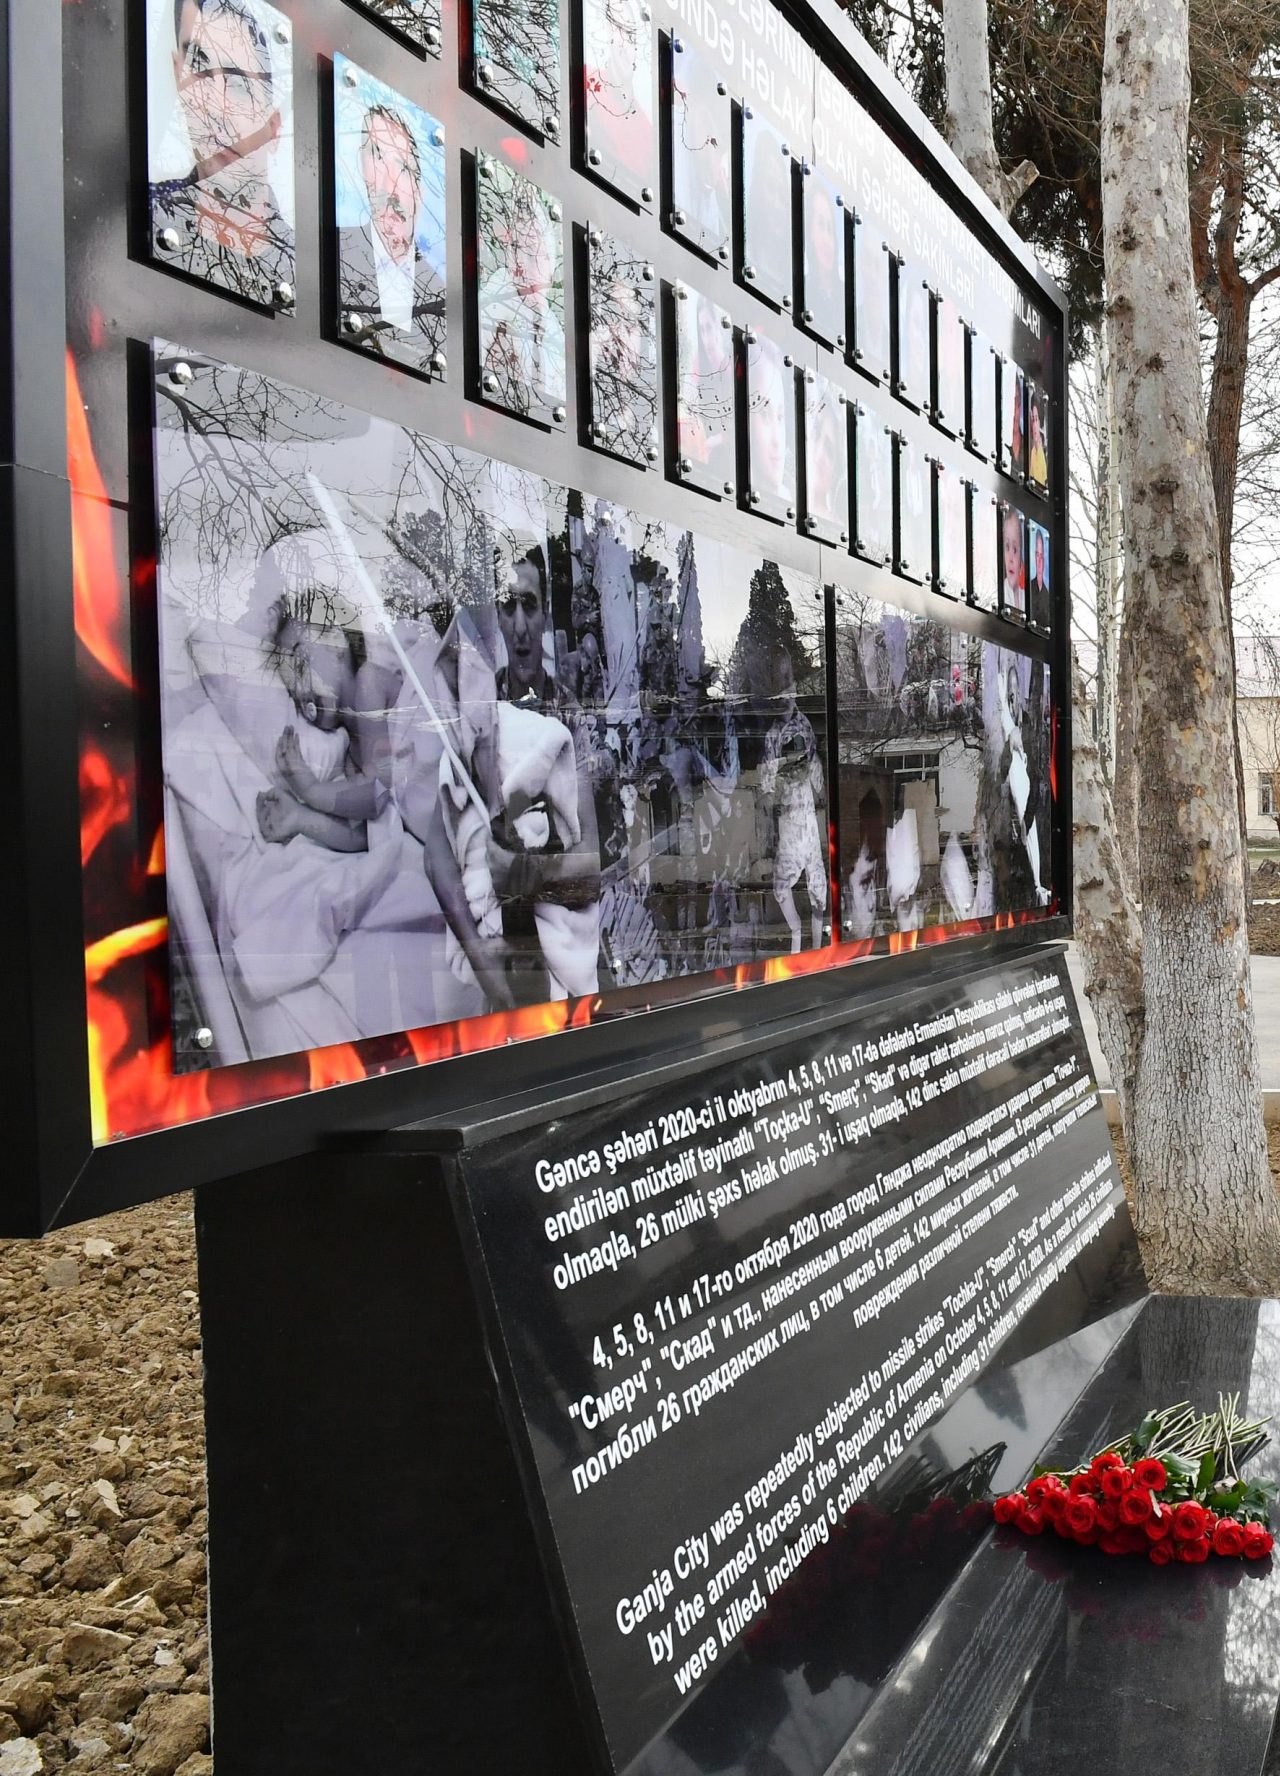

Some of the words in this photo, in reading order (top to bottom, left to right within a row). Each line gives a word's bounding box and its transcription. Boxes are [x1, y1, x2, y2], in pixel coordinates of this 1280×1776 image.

[742, 39, 808, 145] HƏLAK
[812, 116, 859, 193] OLAN
[535, 1149, 601, 1193] Gəncə
[602, 1120, 659, 1175] şəhəri
[657, 1099, 716, 1146] 2020-ci
[713, 1095, 728, 1123] il
[727, 1079, 788, 1118] oktyabrın
[788, 1069, 802, 1096] 4,
[798, 1064, 814, 1091] 5,
[811, 1060, 826, 1086] 8,
[823, 1053, 839, 1079] 11
[837, 1054, 853, 1074] və
[851, 1040, 880, 1068] 17-də
[878, 1026, 916, 1058] dəfələrlə
[912, 1013, 957, 1043] Ermənistan
[953, 998, 997, 1027] Respublikası
[544, 1185, 631, 1242] endirilən
[630, 1148, 698, 1204] müxtəlif
[697, 1126, 755, 1174] təyinatlı
[896, 1063, 910, 1082] və
[908, 1053, 931, 1078] digər
[929, 1042, 951, 1067] raket
[948, 1029, 986, 1059] zərbələrinə
[553, 1230, 637, 1290] olmaqla,
[635, 1212, 660, 1249] 26
[660, 1189, 707, 1236] mülki
[706, 1178, 743, 1219] şəxs
[740, 1155, 780, 1195] həlak
[779, 1142, 820, 1175] olmuş.
[843, 1115, 872, 1145] uşaq
[869, 1095, 909, 1129] olmaqla,
[905, 1086, 923, 1111] 142
[921, 1079, 941, 1102] dinc
[939, 1068, 961, 1093] sakin
[958, 1053, 987, 1083] müxtəlif
[571, 1415, 658, 1495] погибли
[656, 1391, 681, 1433] 26
[681, 1328, 781, 1417] гражданских
[779, 1309, 811, 1344] лиц,
[809, 1299, 821, 1321] в
[818, 1282, 844, 1313] том
[842, 1259, 877, 1294] числе
[874, 1247, 885, 1271] 6
[883, 1227, 915, 1271] детей.
[913, 1215, 931, 1244] 142
[929, 1195, 964, 1232] мирных
[592, 1335, 613, 1370] 4,
[612, 1323, 635, 1357] 5,
[633, 1312, 655, 1345] 8,
[654, 1295, 676, 1331] 11
[677, 1293, 693, 1319] и
[692, 1270, 734, 1308] 17-го
[734, 1235, 791, 1284] октября
[789, 1212, 820, 1251] 2020
[819, 1202, 848, 1233] года
[845, 1182, 880, 1216] город
[875, 1162, 913, 1197] Гянджа
[911, 1129, 967, 1175] неоднократно
[965, 1103, 1009, 1141] подвергался
[720, 1314, 734, 1339] и
[732, 1301, 762, 1331] тд.,
[760, 1245, 840, 1312] нанесенным
[838, 1194, 916, 1259] вооруженными
[913, 1174, 947, 1208] силами
[943, 1145, 989, 1186] Республики
[852, 1263, 920, 1329] повреждения
[918, 1223, 964, 1281] различной
[961, 1205, 992, 1240] степени
[616, 1569, 675, 1635] Ganja
[673, 1531, 710, 1580] City
[709, 1502, 744, 1546] was
[744, 1432, 815, 1515] repeatedly
[814, 1374, 871, 1446] subjected
[868, 1370, 882, 1393] to
[880, 1336, 916, 1382] missile
[914, 1310, 945, 1349] strikes
[646, 1622, 674, 1666] by
[674, 1593, 706, 1637] the
[706, 1532, 758, 1606] armed
[755, 1494, 802, 1553] forces
[801, 1470, 817, 1506] of
[815, 1457, 838, 1491] the
[835, 1407, 886, 1470] Republic
[884, 1388, 898, 1419] of
[896, 1356, 936, 1409] Armenia
[934, 1345, 948, 1369] on
[945, 1313, 978, 1356] October
[673, 1636, 718, 1695] were
[716, 1578, 767, 1648] killed,
[764, 1513, 830, 1596] including
[826, 1497, 838, 1525] 6
[837, 1454, 886, 1515] children.
[883, 1428, 904, 1465] 142
[903, 1390, 945, 1441] civilians,
[940, 1348, 981, 1399] including
